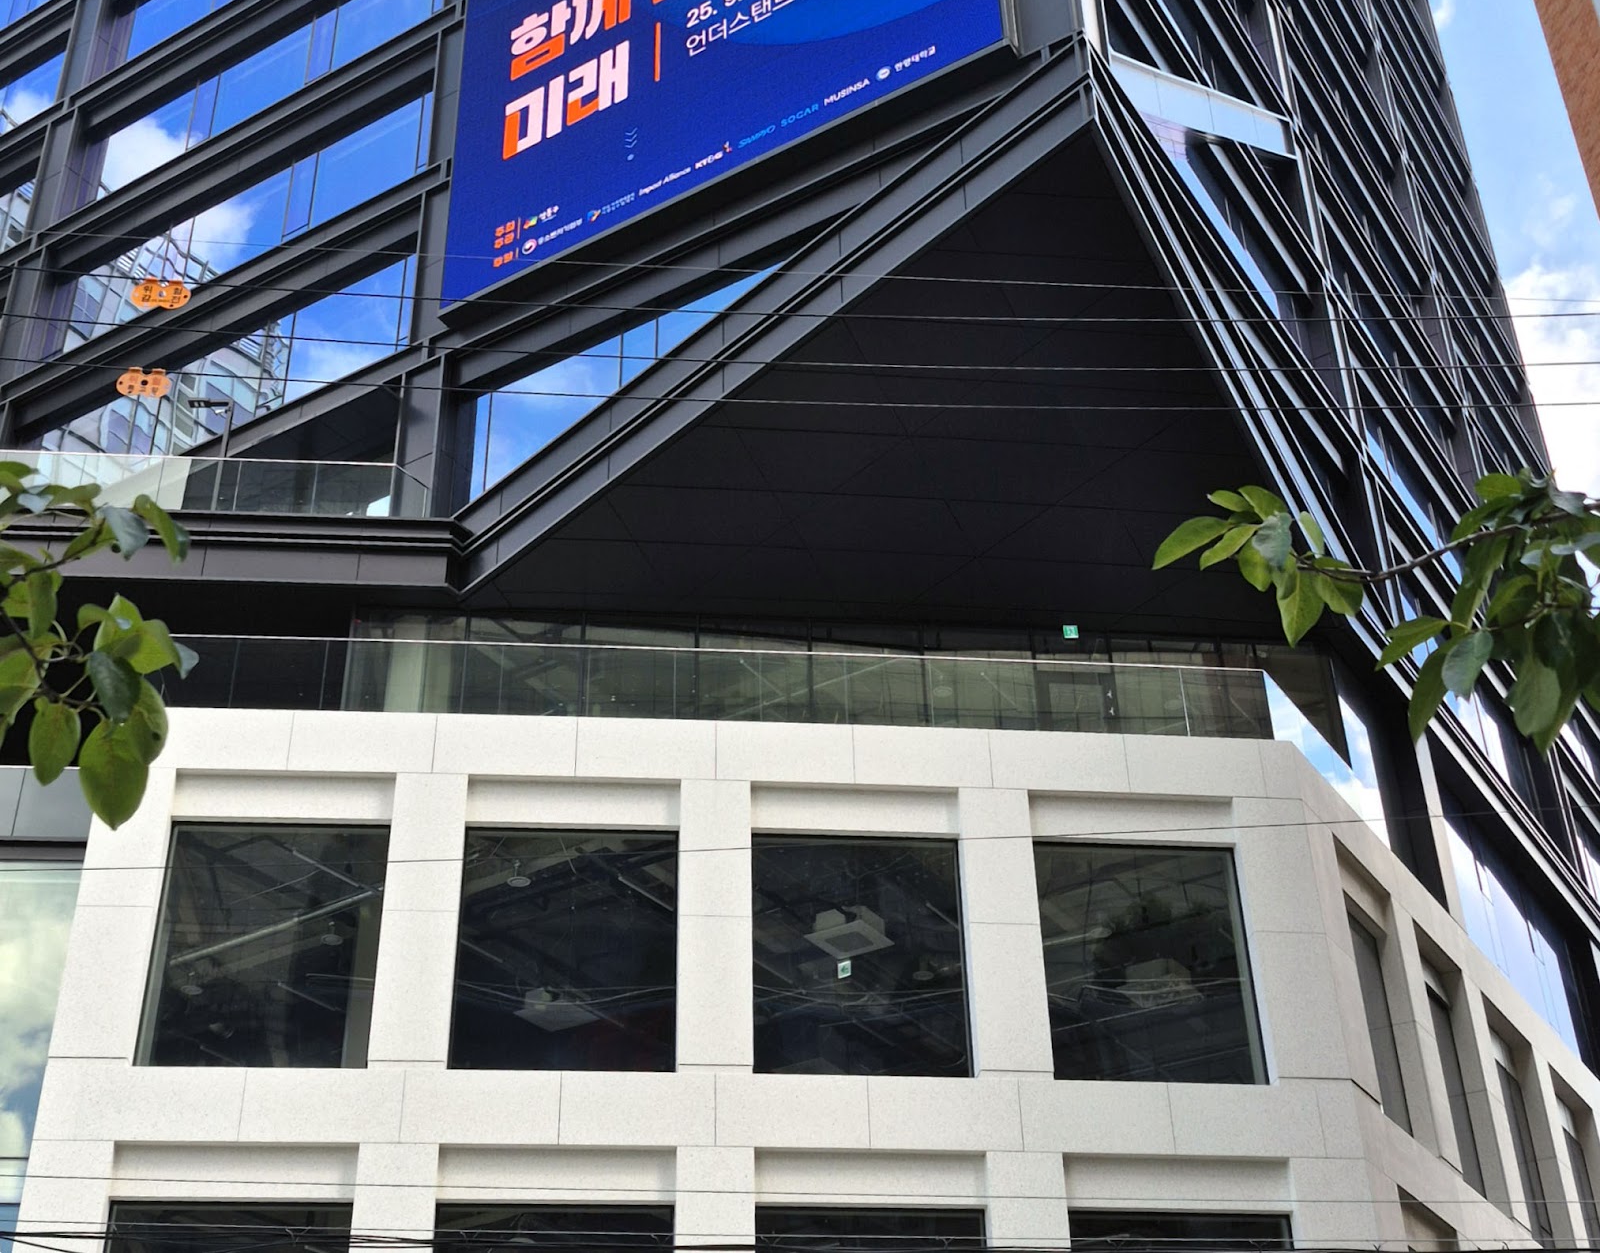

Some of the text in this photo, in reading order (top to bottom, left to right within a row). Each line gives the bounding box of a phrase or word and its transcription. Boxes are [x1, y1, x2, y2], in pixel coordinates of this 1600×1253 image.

[502, 41, 630, 161] 미래
[824, 78, 870, 106] MUSINSA
[781, 103, 819, 127] SOCAR
[695, 151, 724, 170] KT&G
